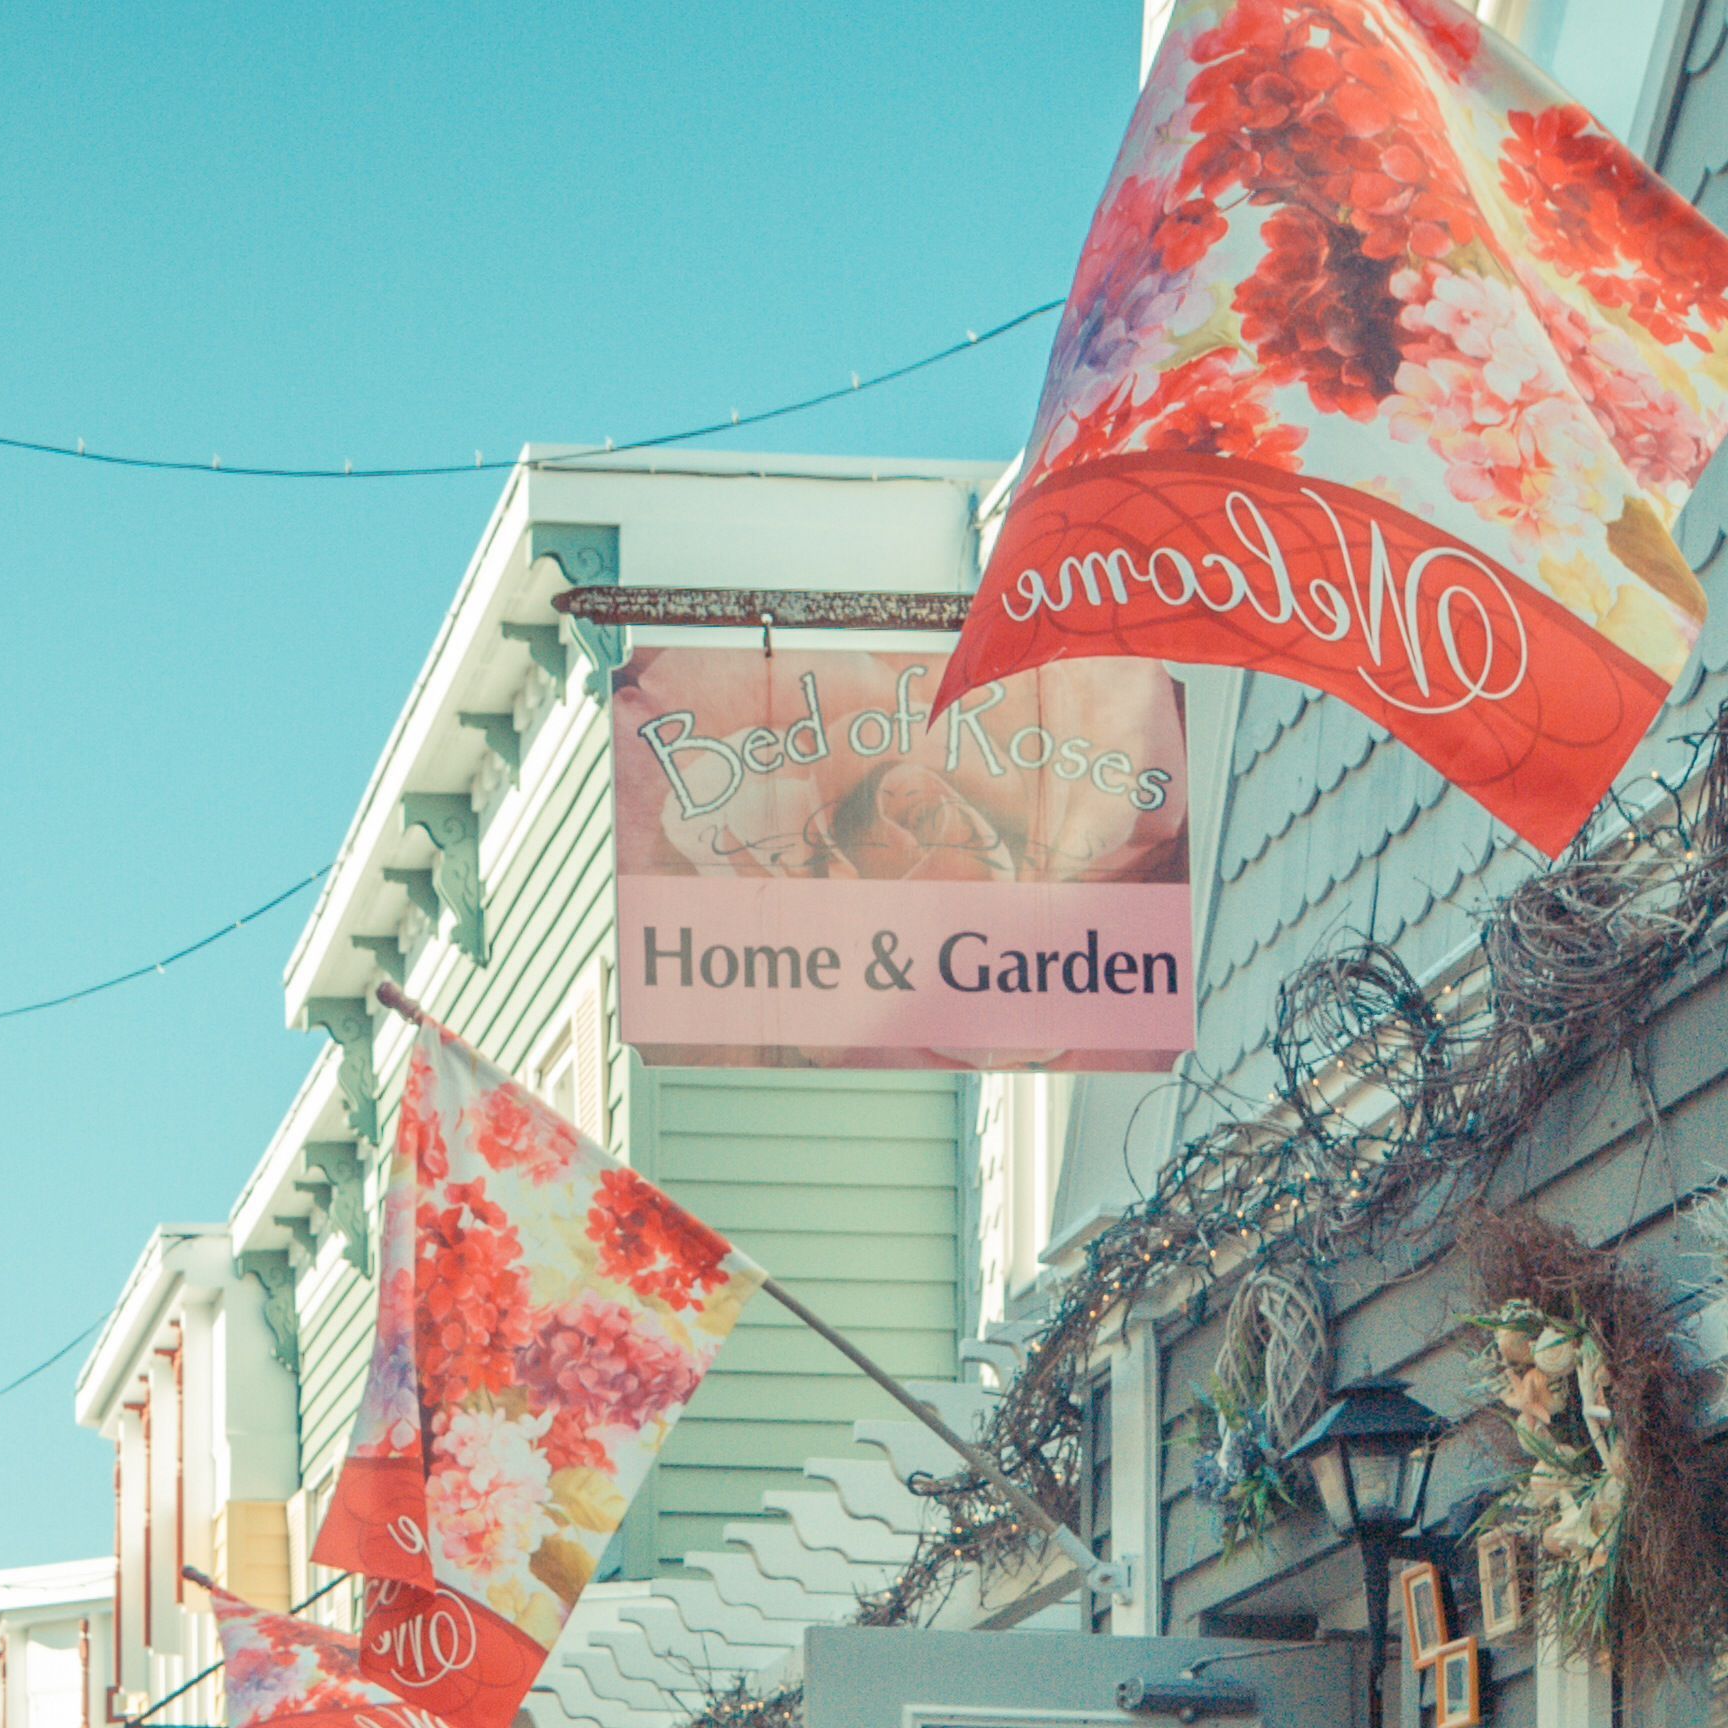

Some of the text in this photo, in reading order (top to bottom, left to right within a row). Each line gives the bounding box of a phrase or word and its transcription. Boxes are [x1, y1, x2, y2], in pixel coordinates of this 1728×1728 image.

[637, 666, 1172, 820] Bed of Roses
[643, 925, 1178, 996] Home & Garden
